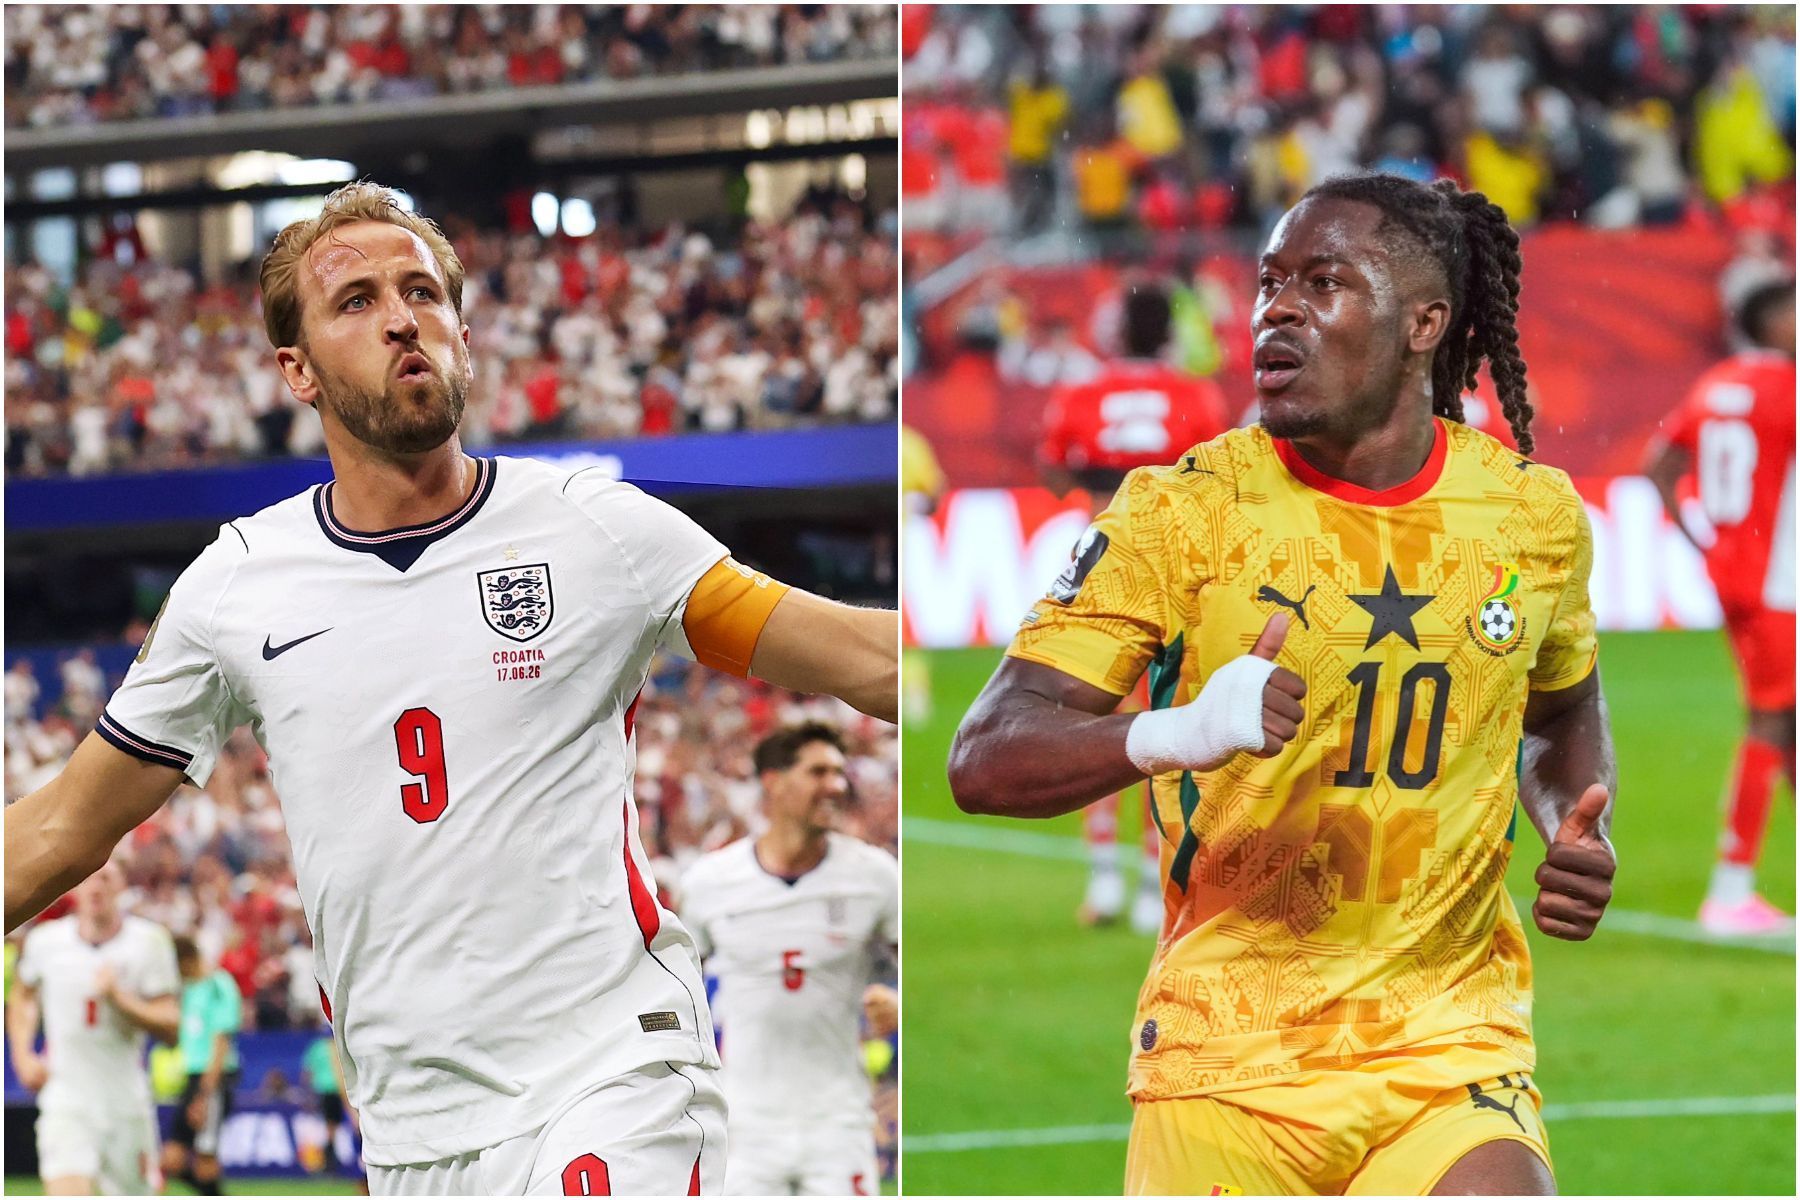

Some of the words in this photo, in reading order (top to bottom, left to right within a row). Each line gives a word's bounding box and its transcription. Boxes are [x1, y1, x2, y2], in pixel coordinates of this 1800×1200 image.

[493, 650, 545, 664] CROATIA
[1475, 640, 1504, 657] FOOTBALL
[497, 665, 540, 681] 17.06.26
[1333, 661, 1452, 790] 10
[393, 706, 448, 824] 9
[782, 949, 804, 992] 5
